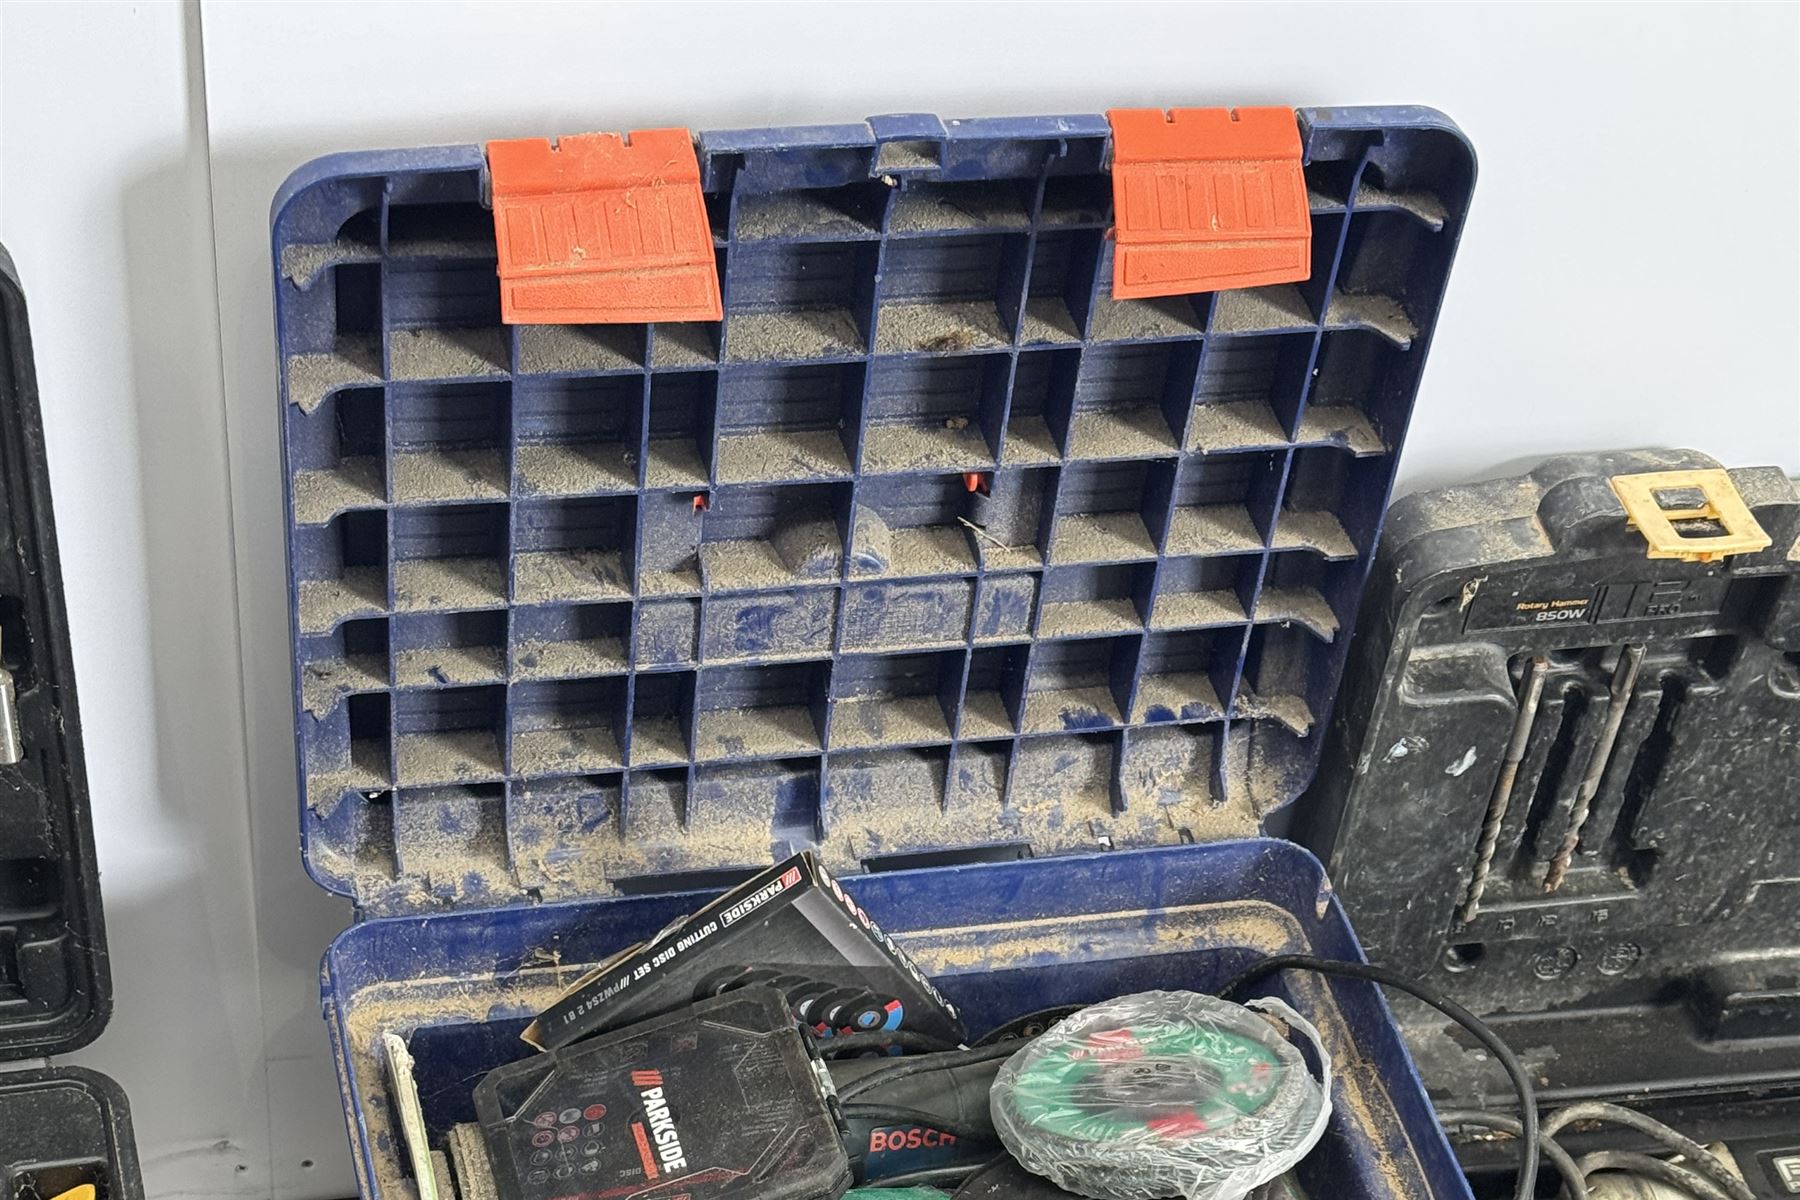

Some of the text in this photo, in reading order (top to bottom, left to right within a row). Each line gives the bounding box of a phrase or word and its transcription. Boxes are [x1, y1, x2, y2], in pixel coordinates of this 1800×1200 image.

[1515, 599, 1589, 611] Rotary Hammer
[1536, 608, 1586, 621] 850W
[724, 877, 784, 924] PARKSIDE
[676, 920, 718, 953] CUTTING
[652, 947, 677, 968] DISC
[633, 966, 652, 981] SET
[640, 1086, 688, 1174] PARKSIDE
